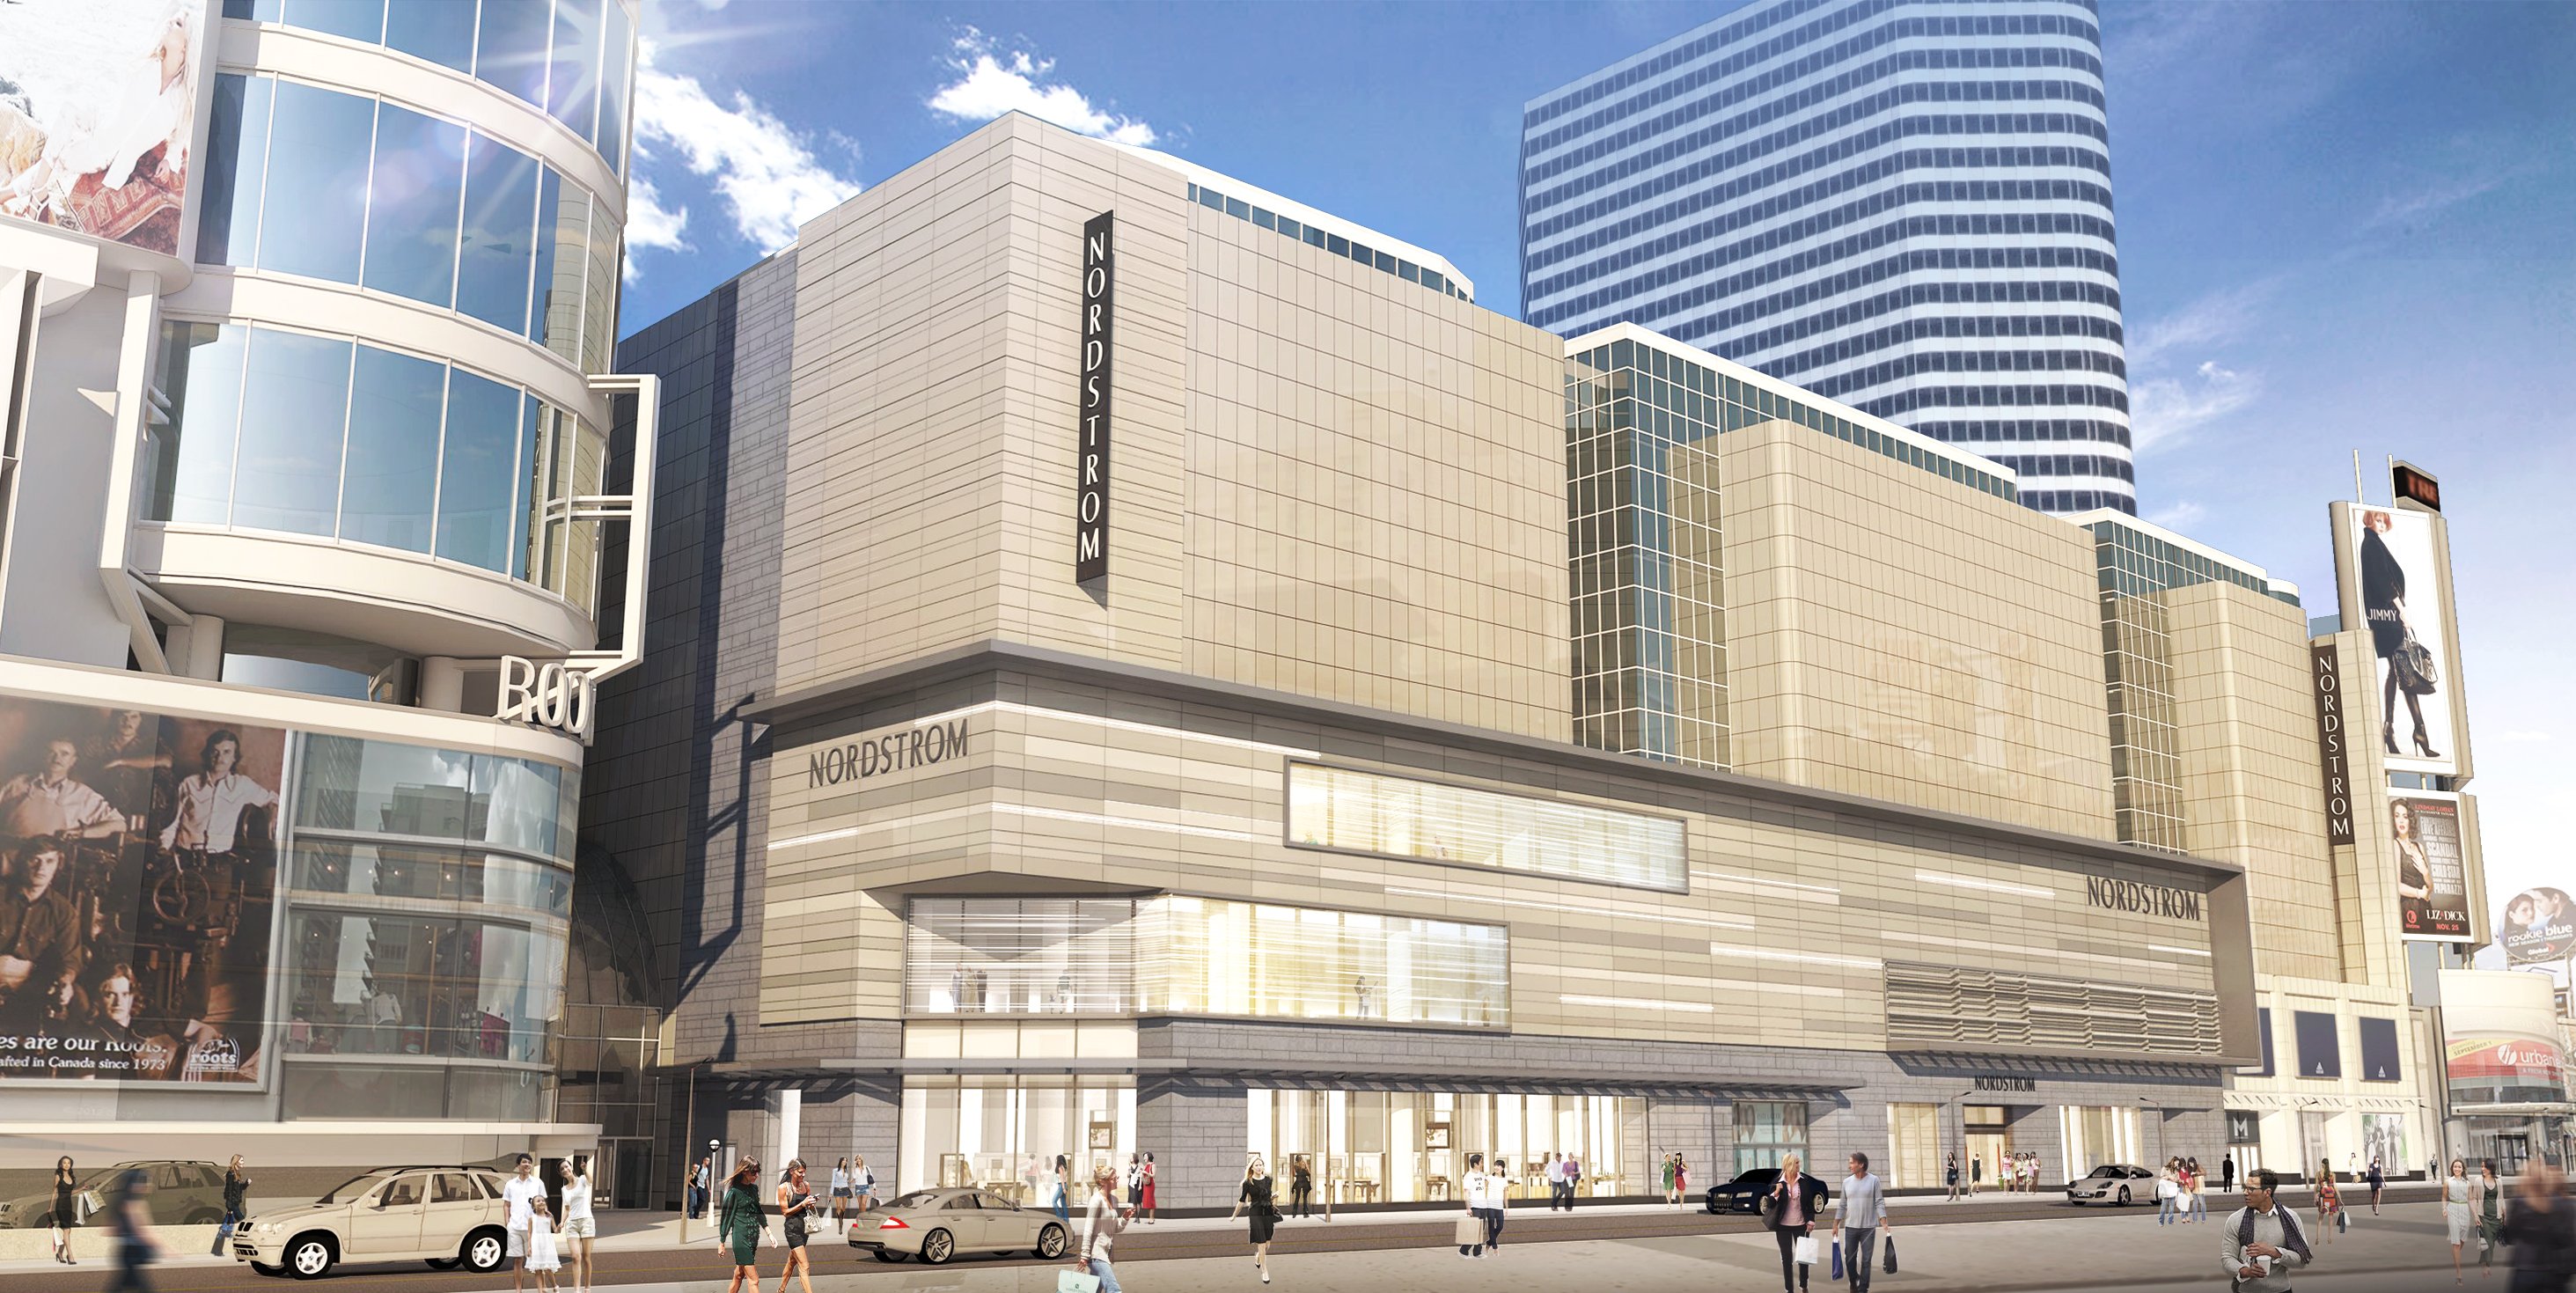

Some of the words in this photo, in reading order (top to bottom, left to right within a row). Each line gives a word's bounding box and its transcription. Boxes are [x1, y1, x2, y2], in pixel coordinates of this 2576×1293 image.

[1081, 231, 1105, 562] NORDSTROM
[2367, 608, 2396, 621] JIMMY
[809, 717, 968, 789] NORDSTROM
[2318, 655, 2350, 836] NORDSTROM
[2426, 841, 2459, 858] SCANDAL
[2087, 876, 2200, 922] NORDSTROM
[2508, 929, 2543, 943] rookie
[2545, 923, 2573, 936] blue
[24, 1037, 58, 1049] are
[63, 1038, 99, 1050] our
[33, 1057, 45, 1068] in
[48, 1056, 94, 1069] Canada
[99, 1059, 129, 1069] since
[134, 1059, 165, 1070] 1973
[190, 1053, 237, 1064] roots
[1975, 1075, 2036, 1092] NORDSTROM
[2233, 1116, 2249, 1136] M
